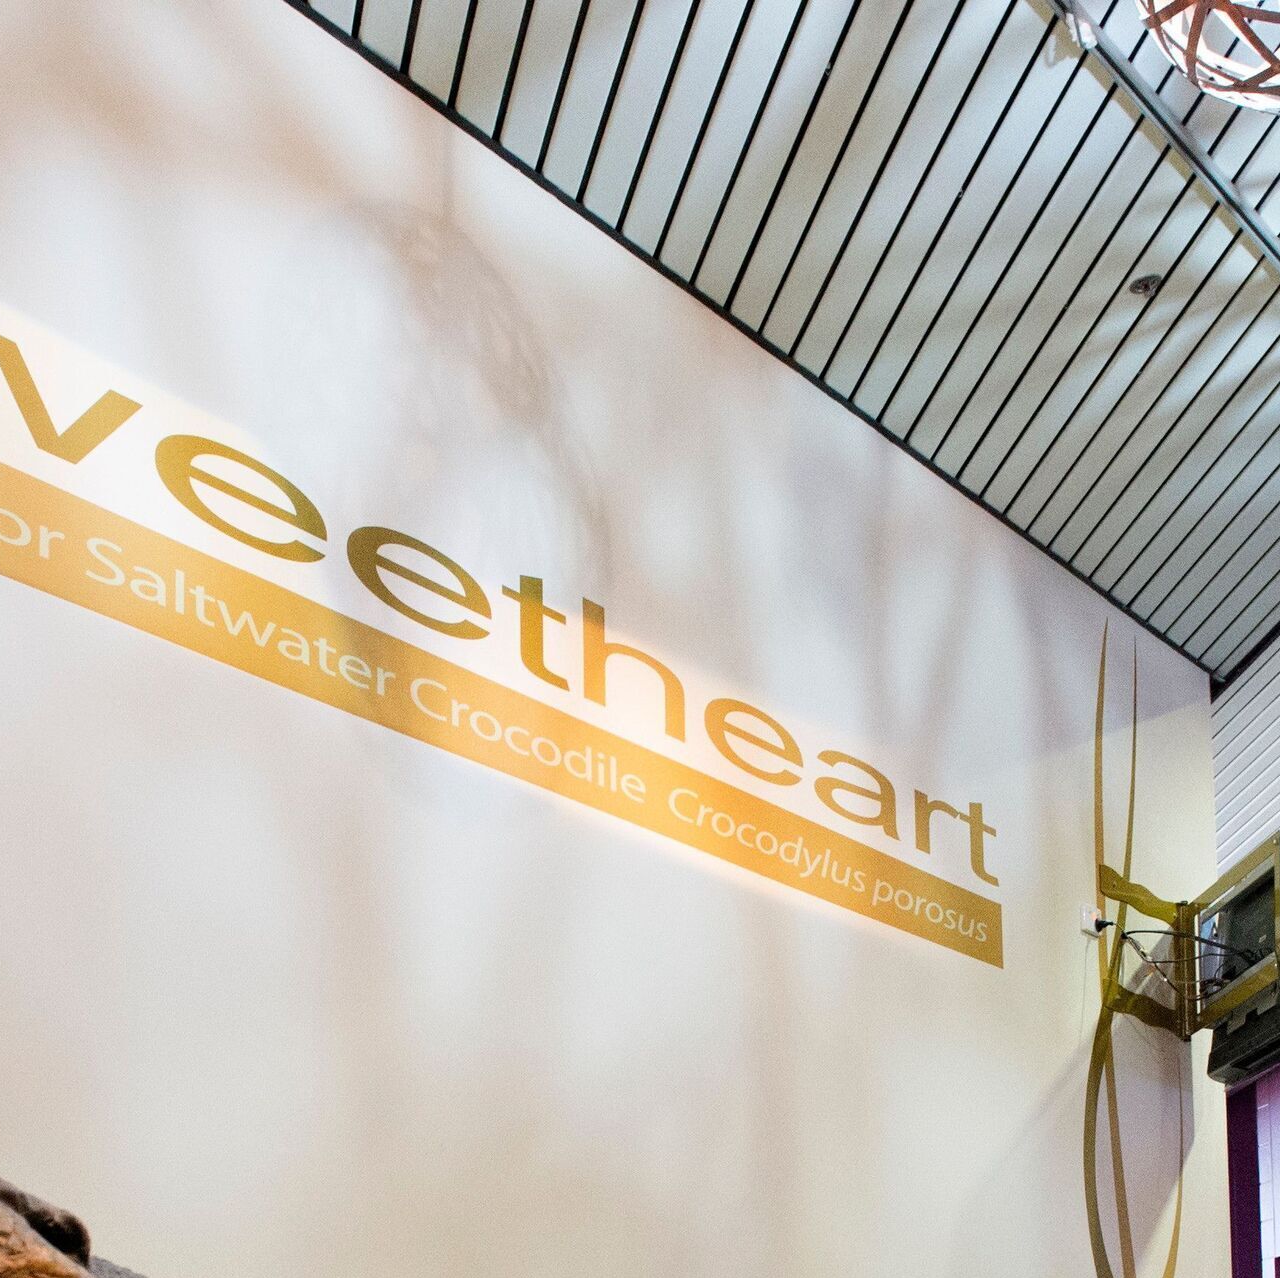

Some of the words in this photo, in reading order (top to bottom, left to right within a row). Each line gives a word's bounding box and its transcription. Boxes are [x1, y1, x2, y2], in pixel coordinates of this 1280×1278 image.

[84, 537, 397, 696] Saltwater
[410, 677, 647, 804] Crocodile
[668, 786, 867, 893] Crocodylus
[872, 877, 988, 942] porosus
